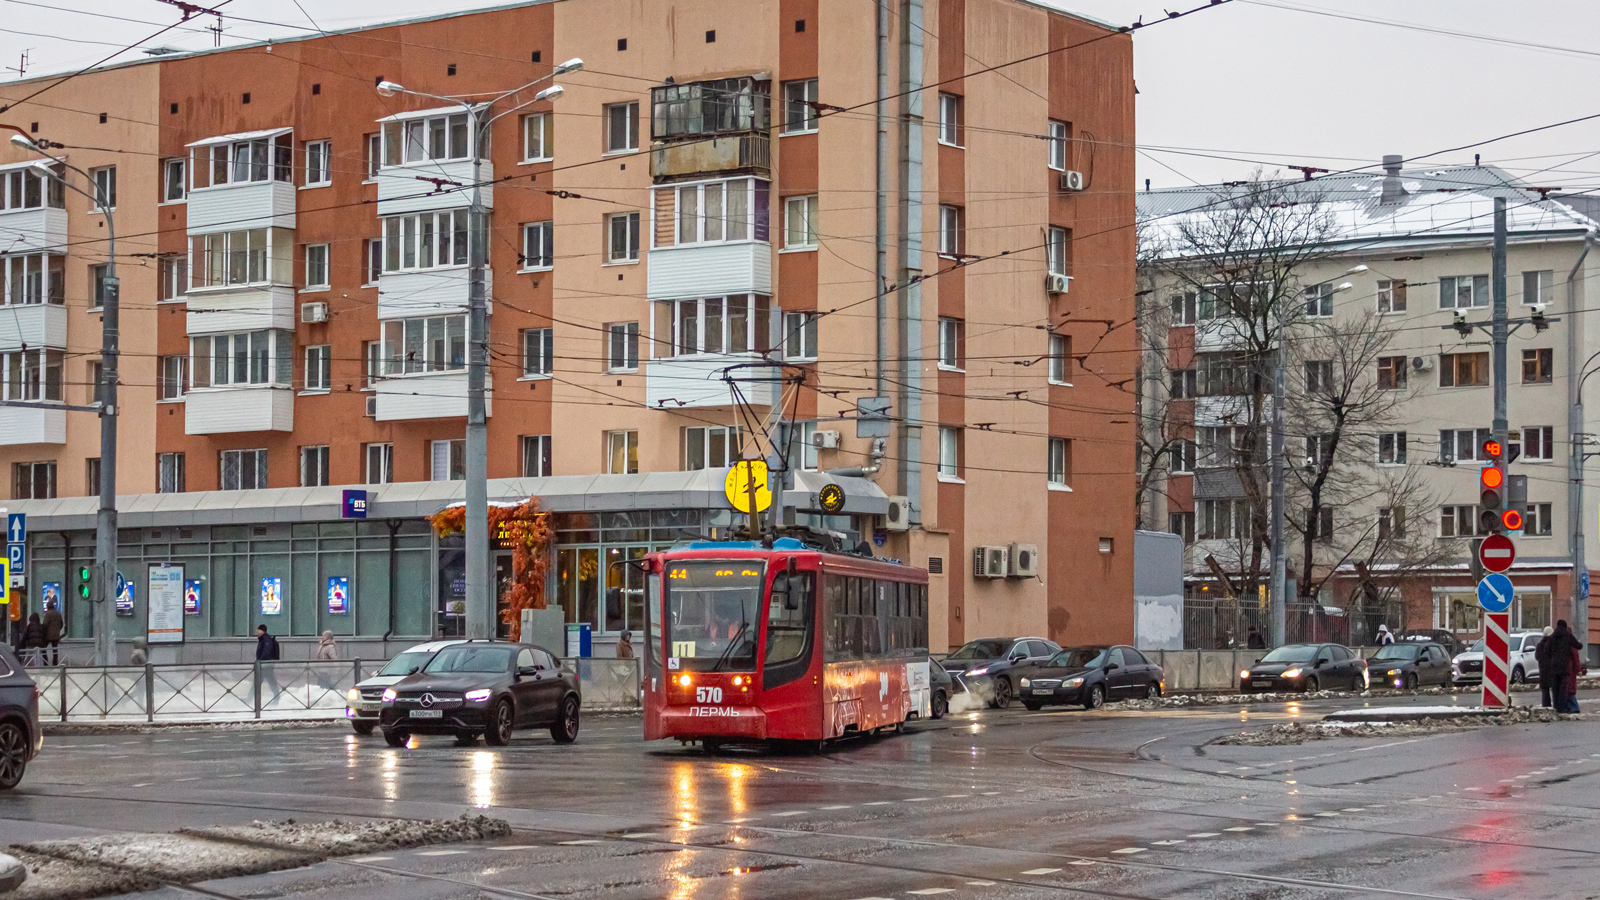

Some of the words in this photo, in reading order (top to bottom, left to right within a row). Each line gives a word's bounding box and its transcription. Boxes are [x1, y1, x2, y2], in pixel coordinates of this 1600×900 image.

[353, 499, 366, 508] ВТБ
[669, 568, 687, 579] 44
[677, 643, 689, 657] 11
[696, 686, 723, 703] 570
[688, 706, 740, 717] ПЕРМЬ
